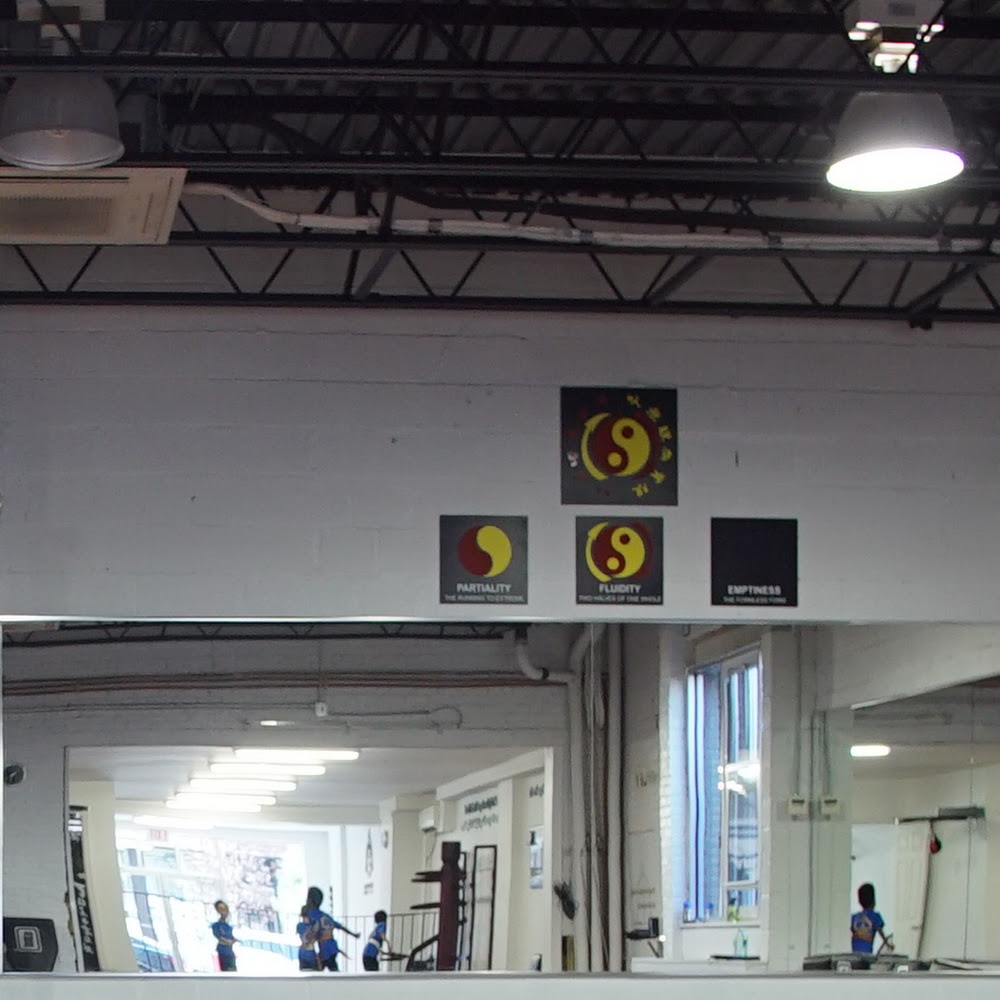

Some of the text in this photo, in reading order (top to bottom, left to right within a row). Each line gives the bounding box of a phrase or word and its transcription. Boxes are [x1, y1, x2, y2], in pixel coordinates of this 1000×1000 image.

[456, 582, 512, 593] PARTIALITY
[598, 583, 642, 594] FLUIDITY
[727, 584, 782, 596] EMPTINESS
